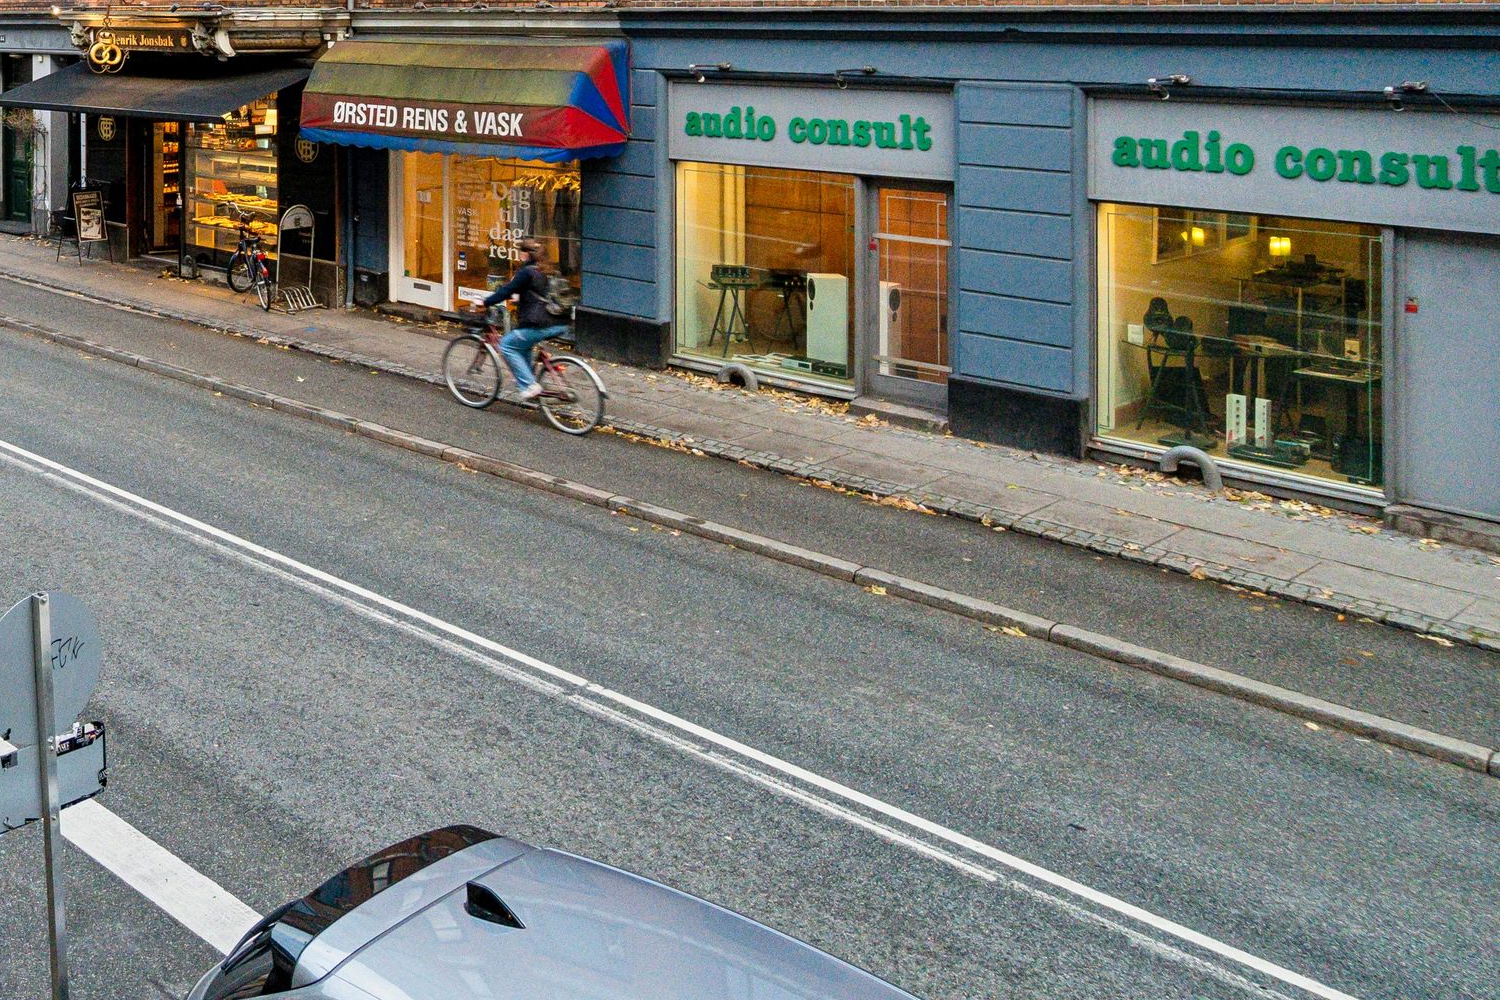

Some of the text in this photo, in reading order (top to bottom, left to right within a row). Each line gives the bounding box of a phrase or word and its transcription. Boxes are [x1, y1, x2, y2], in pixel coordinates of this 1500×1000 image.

[140, 34, 174, 47] Jonsbak
[333, 101, 524, 137] ØRSTED RENS & VASK
[685, 106, 932, 151] audio consult
[1111, 130, 1255, 176] audio
[491, 181, 531, 210] Dag
[500, 205, 519, 224] til
[489, 222, 524, 249] dag
[488, 244, 521, 262] ren
